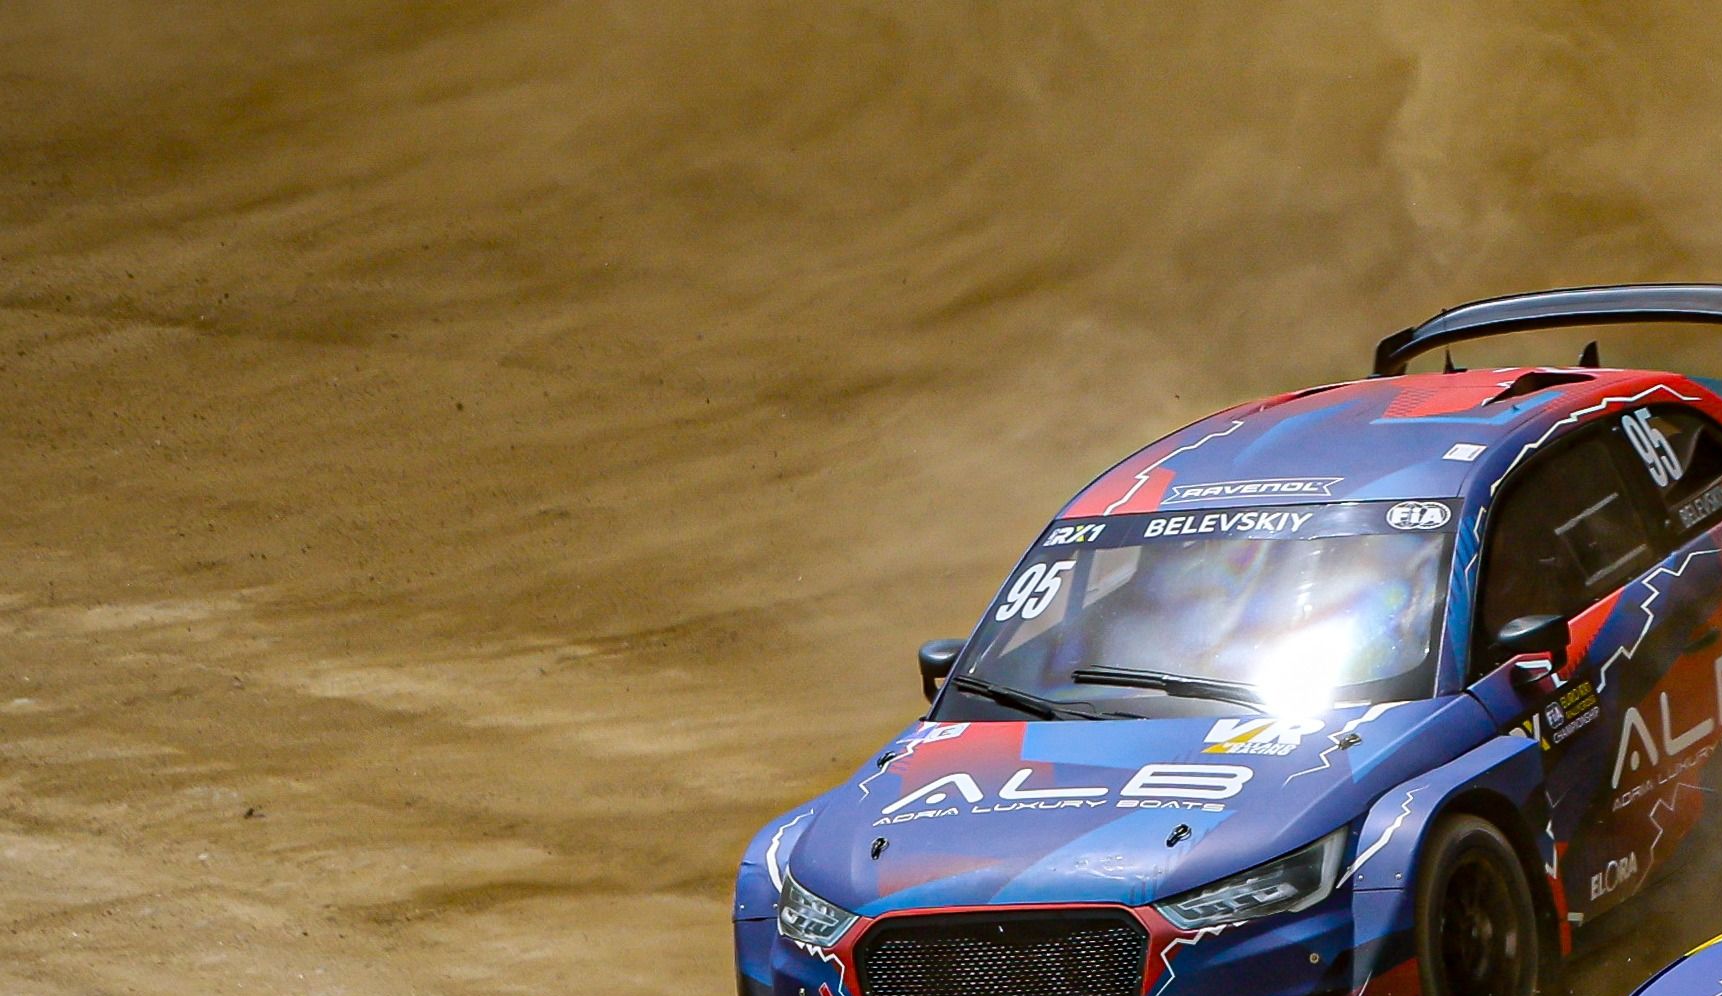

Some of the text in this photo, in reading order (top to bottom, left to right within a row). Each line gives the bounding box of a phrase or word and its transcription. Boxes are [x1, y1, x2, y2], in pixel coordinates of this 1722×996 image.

[1621, 407, 1683, 487] 95
[1181, 481, 1320, 499] RAVENOL
[1143, 511, 1313, 538] BELEVSKIY
[996, 560, 1076, 621] 95
[872, 799, 1226, 828] ADRIA LUXURY BOATS
[881, 764, 1254, 815] ALB
[1591, 851, 1637, 901] ELORA
